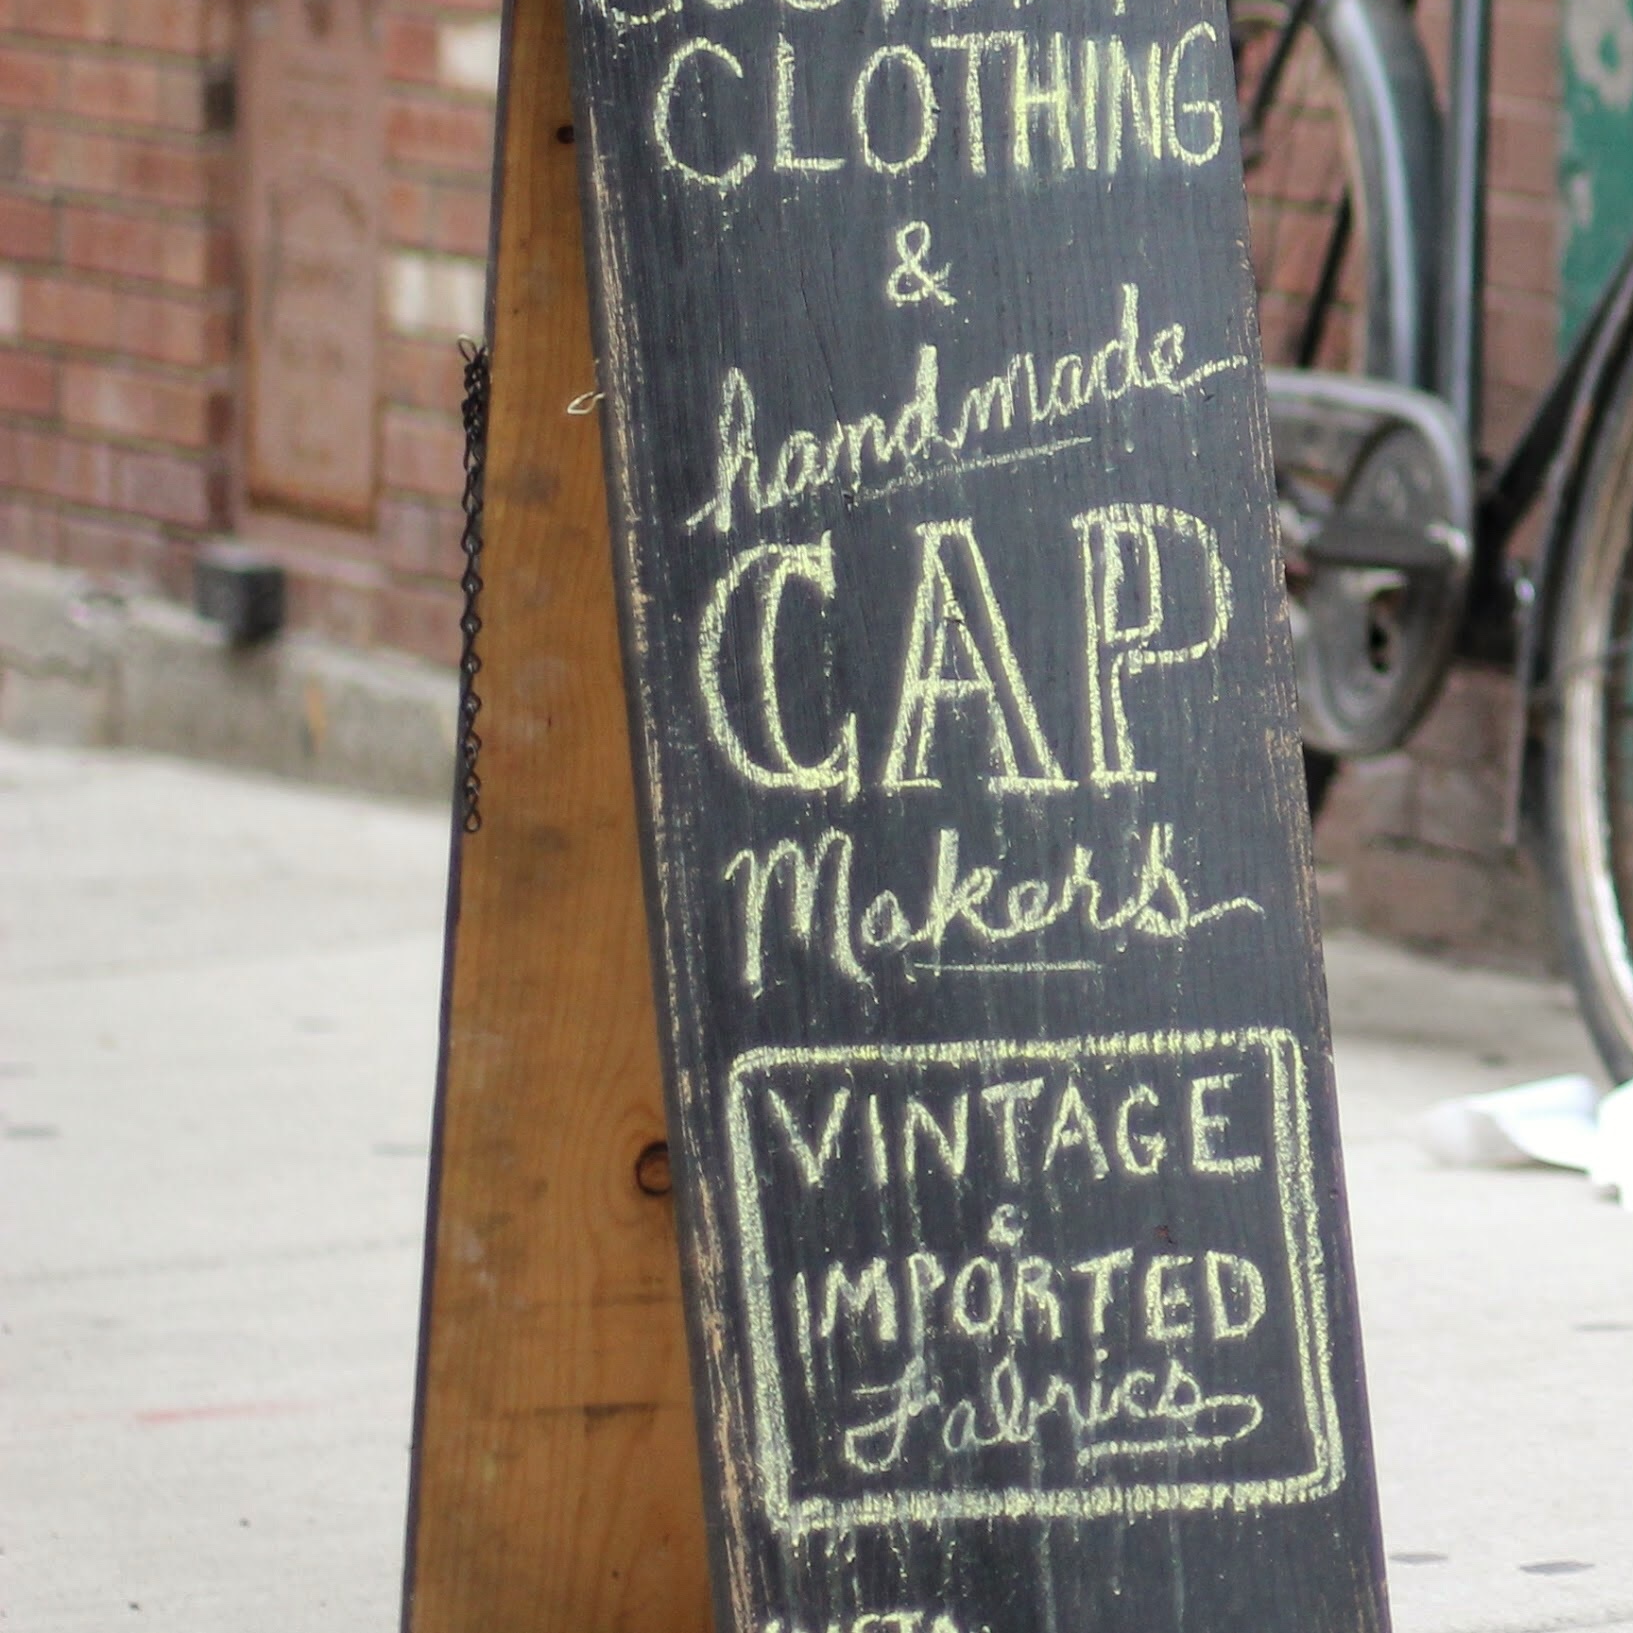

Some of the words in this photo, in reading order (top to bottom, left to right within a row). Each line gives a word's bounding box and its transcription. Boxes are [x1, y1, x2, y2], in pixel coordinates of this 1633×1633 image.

[652, 21, 1224, 188] CLOTHING
[886, 220, 958, 309] &
[683, 284, 1250, 533] handmade
[697, 503, 1234, 803] CAP
[723, 822, 1265, 1000] Makers
[766, 1072, 1264, 1185] VINTAGE
[794, 1249, 1267, 1354] IMPORTED
